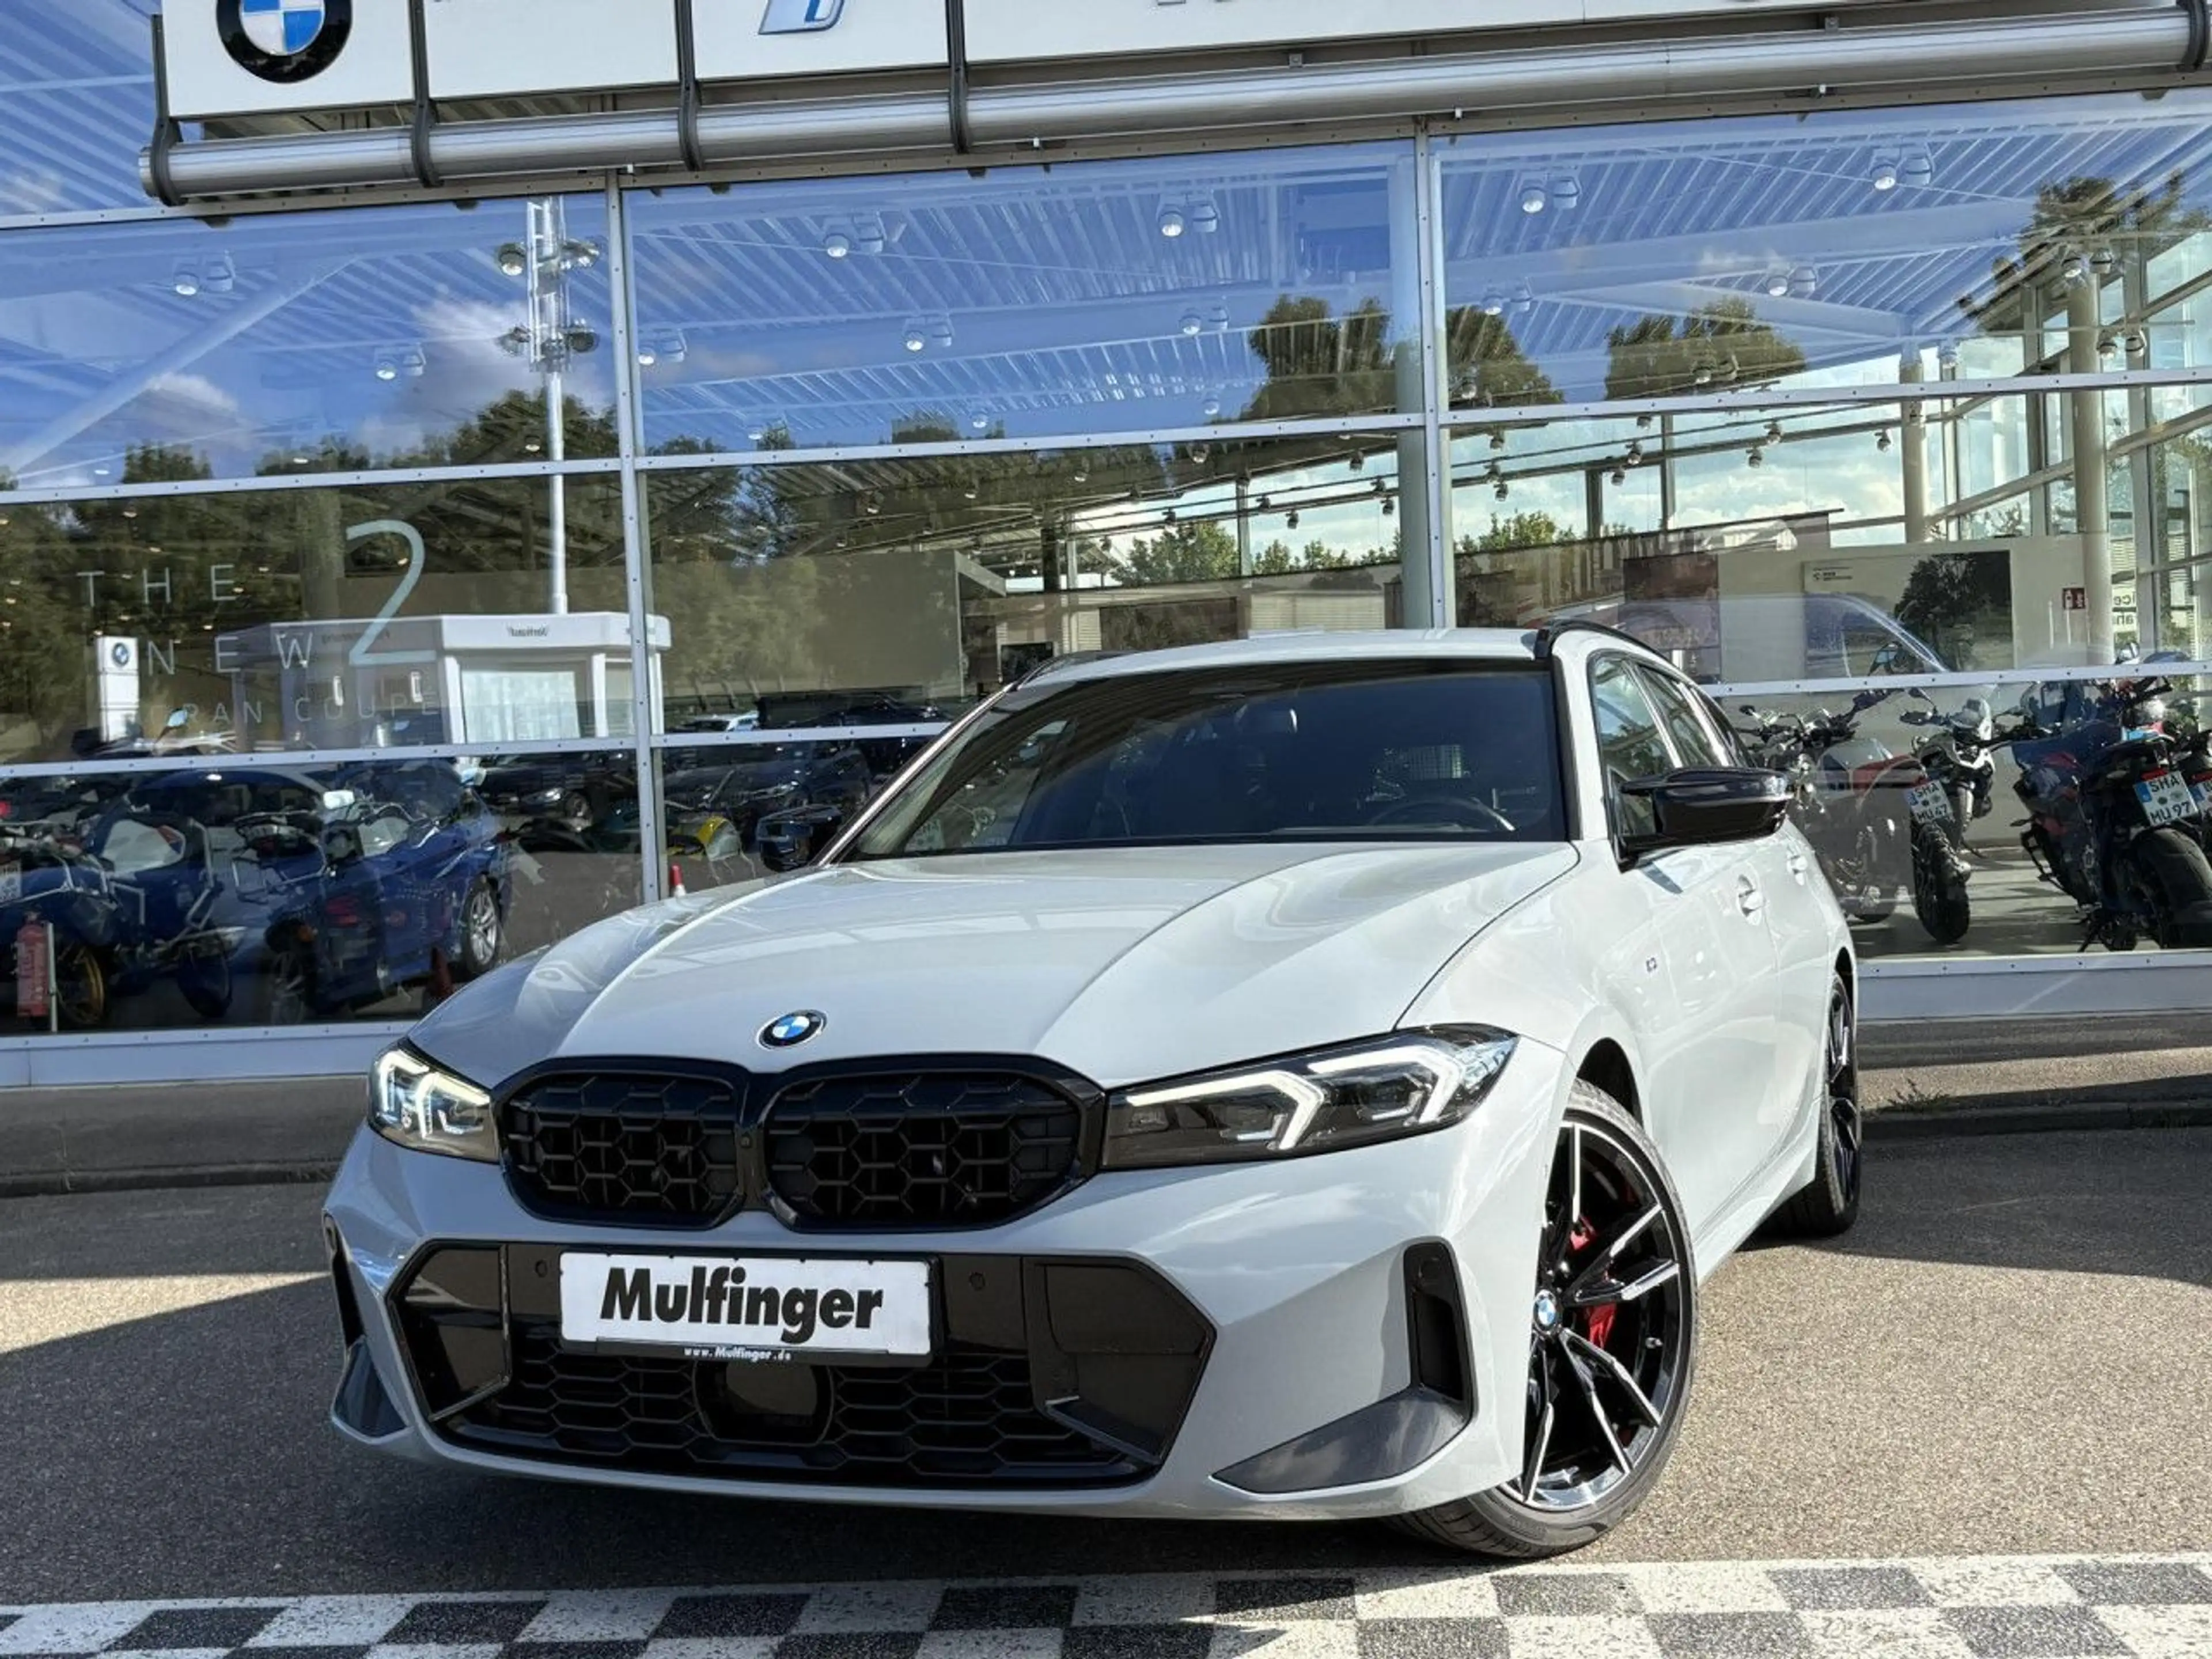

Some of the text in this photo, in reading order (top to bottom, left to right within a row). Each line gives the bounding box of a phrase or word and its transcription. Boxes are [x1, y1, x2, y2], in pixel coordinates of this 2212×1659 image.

[77, 565, 236, 607] THE
[347, 518, 436, 665] 2
[148, 632, 313, 675] NEW
[2148, 774, 2180, 793] SHA
[2149, 801, 2191, 824] MU 97
[600, 1266, 884, 1344] Mulfinger
